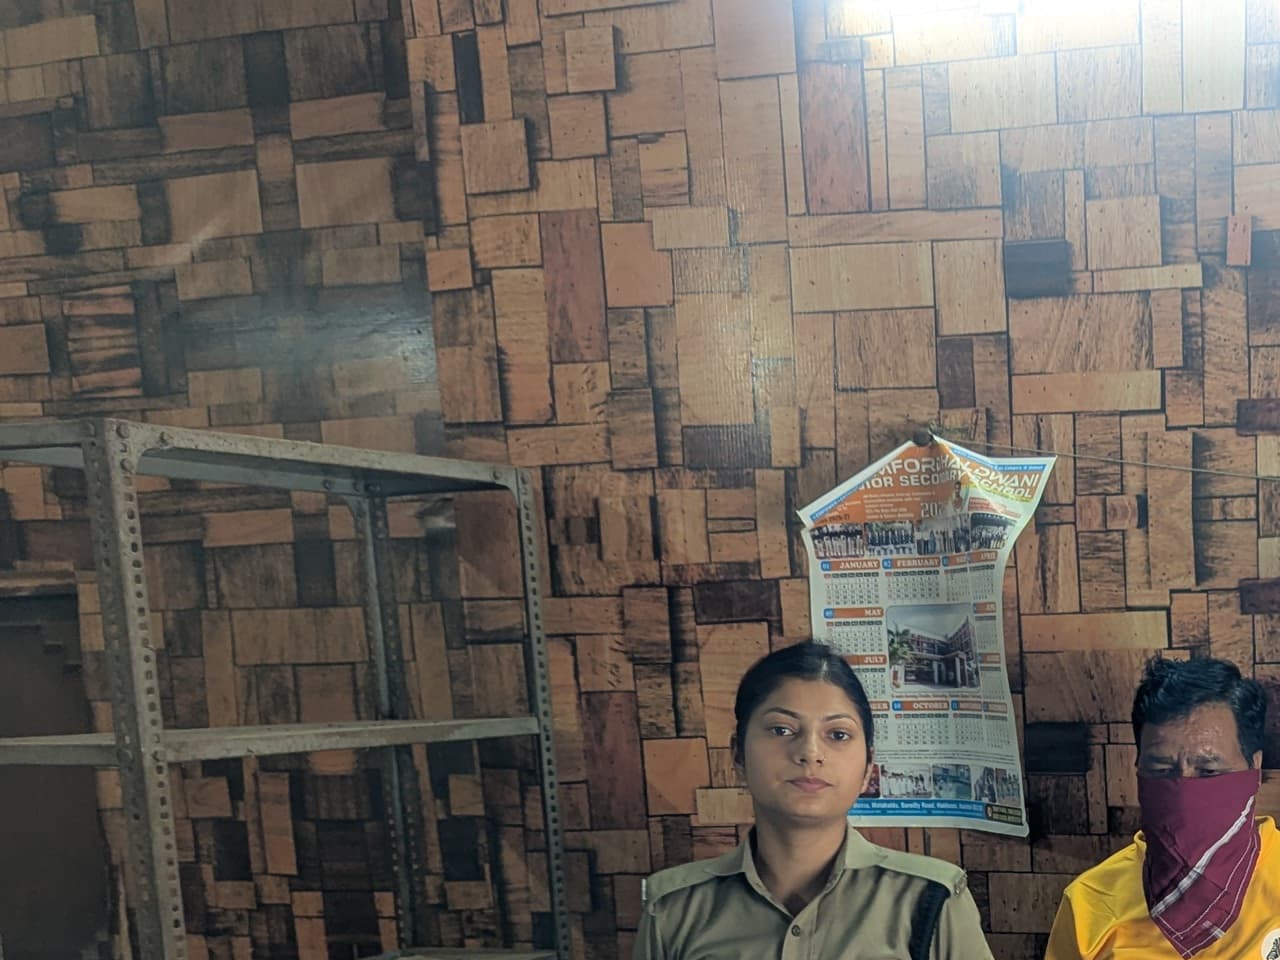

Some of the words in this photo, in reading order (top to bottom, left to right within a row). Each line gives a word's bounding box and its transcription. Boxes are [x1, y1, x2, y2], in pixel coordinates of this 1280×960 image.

[839, 560, 879, 570] JANUARY
[897, 558, 940, 568] FEBRUARY
[864, 608, 883, 616] MAY
[863, 655, 885, 664] JULY
[912, 701, 949, 710] OCTOBER
